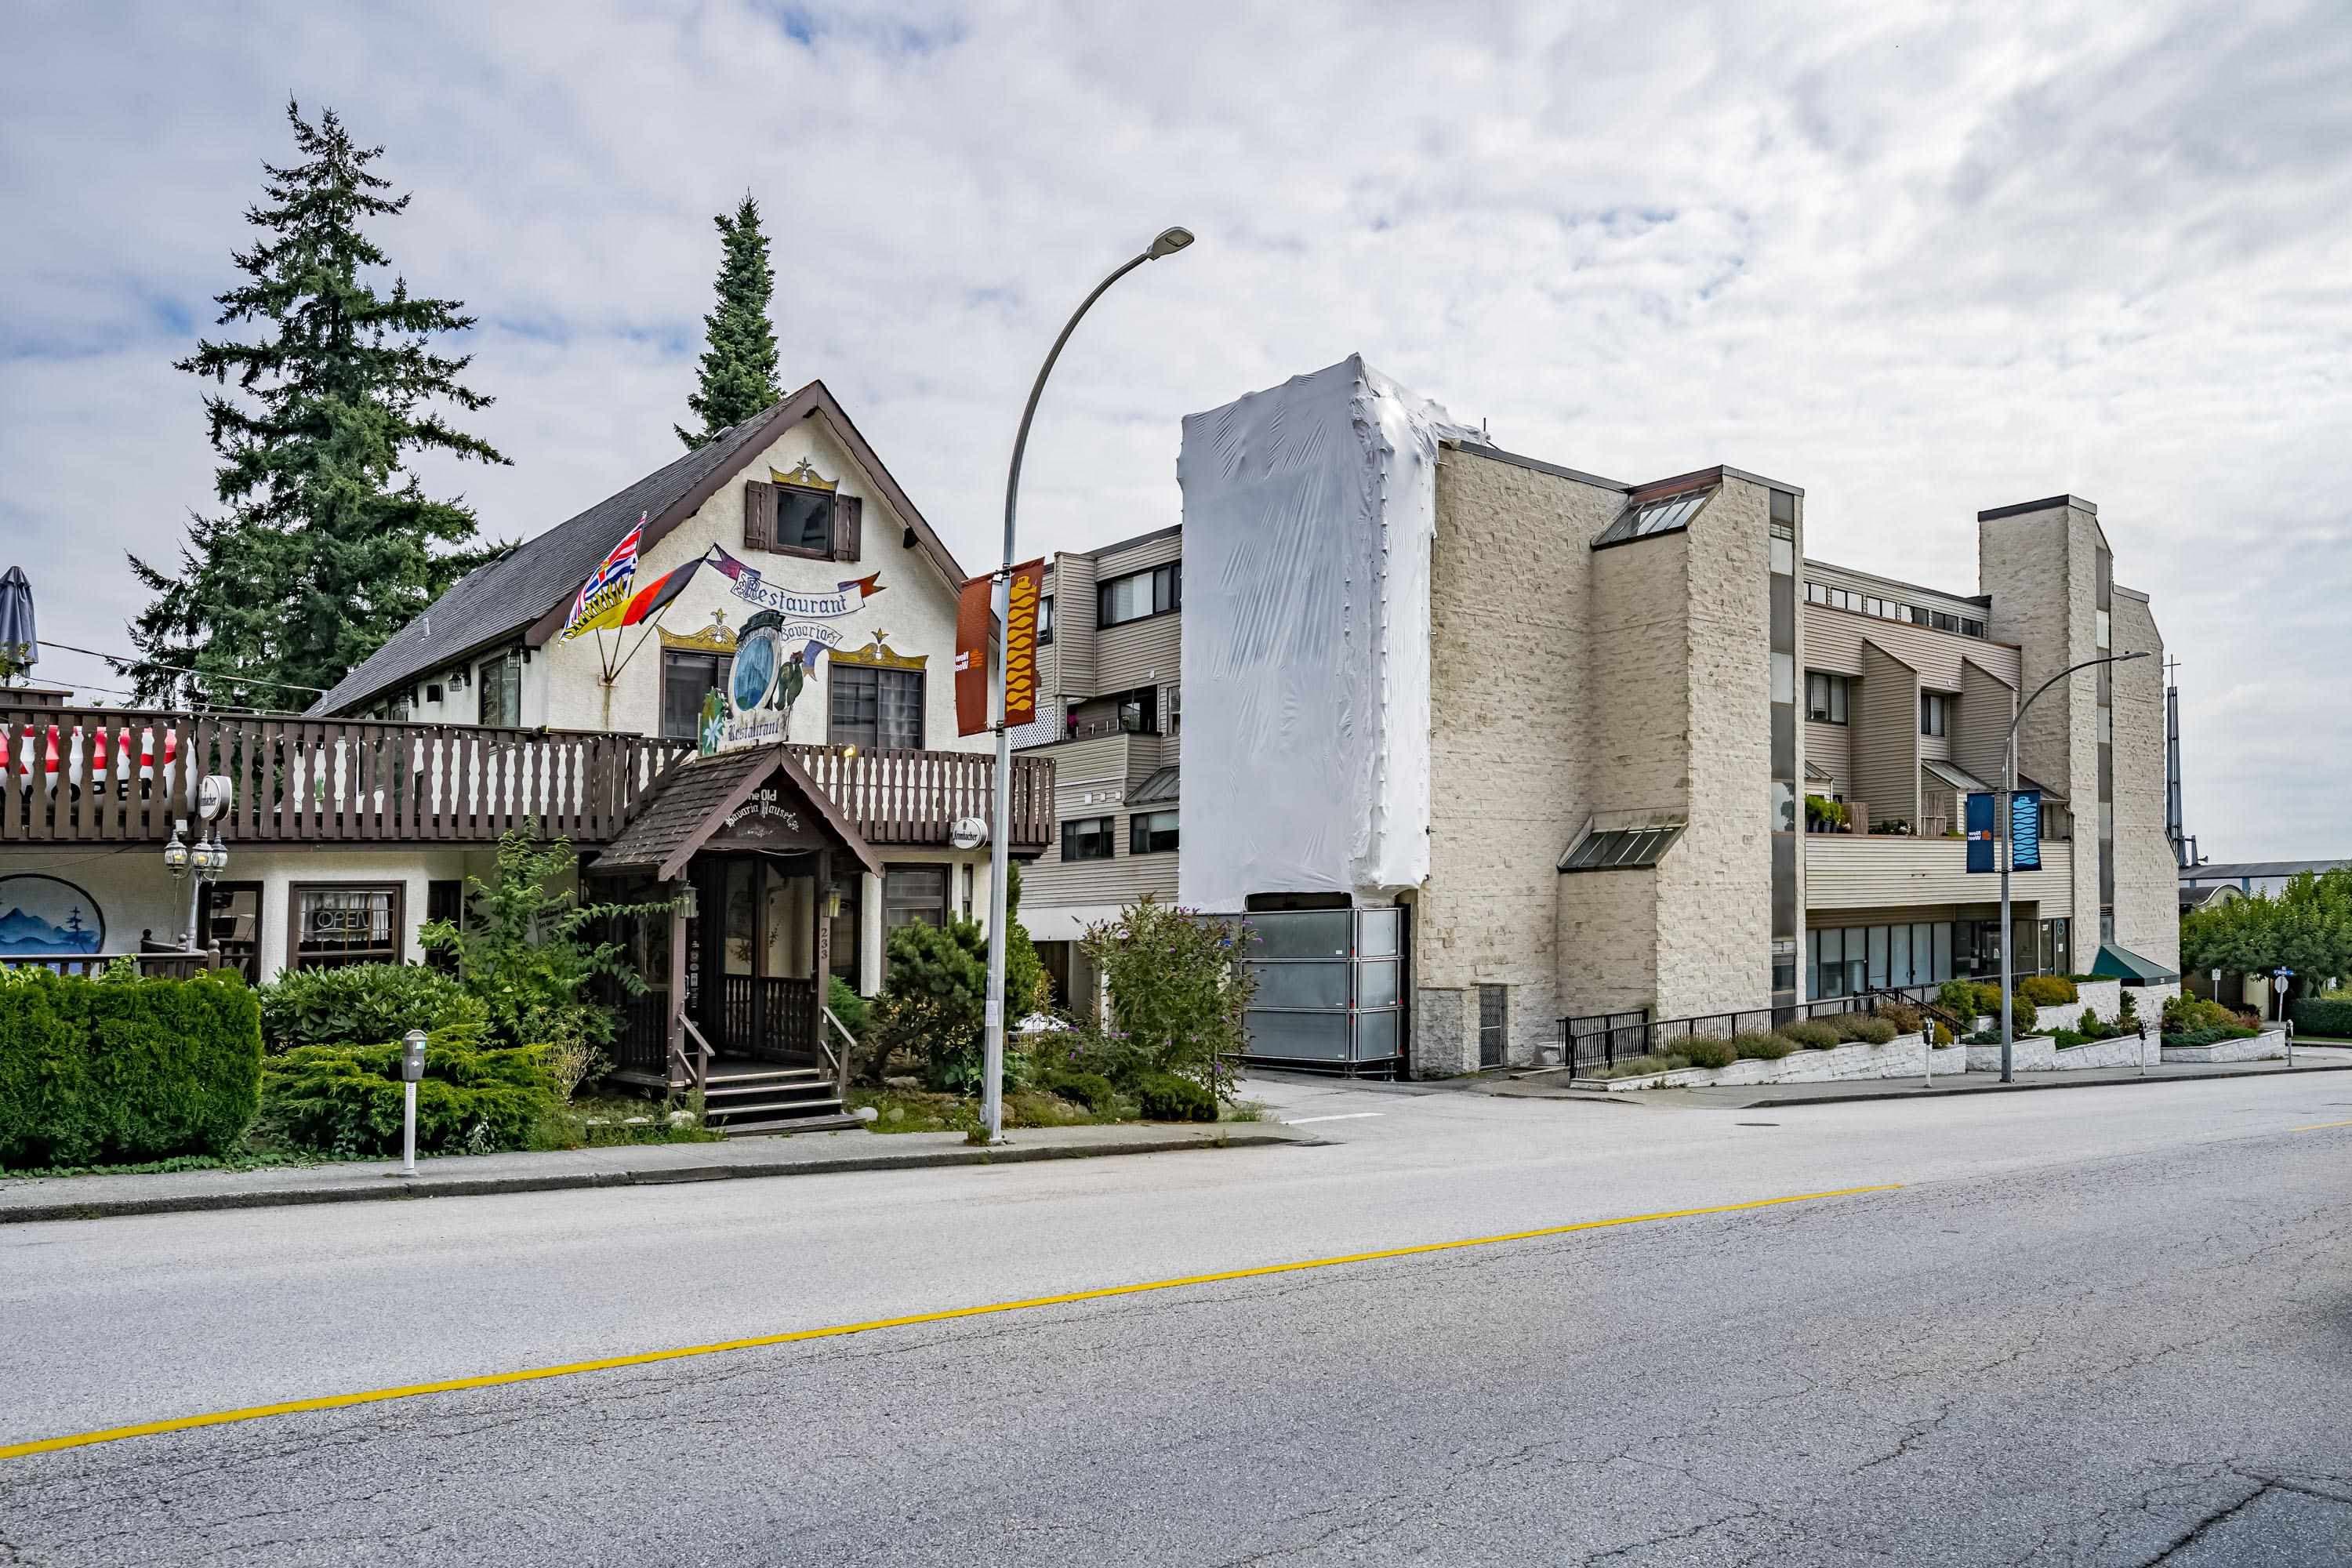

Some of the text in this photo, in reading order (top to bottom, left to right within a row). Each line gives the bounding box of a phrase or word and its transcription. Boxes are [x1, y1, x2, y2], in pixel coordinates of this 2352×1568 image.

[744, 577, 848, 614] Restaurant
[760, 789, 777, 801] Old
[317, 911, 370, 929] OPEN
